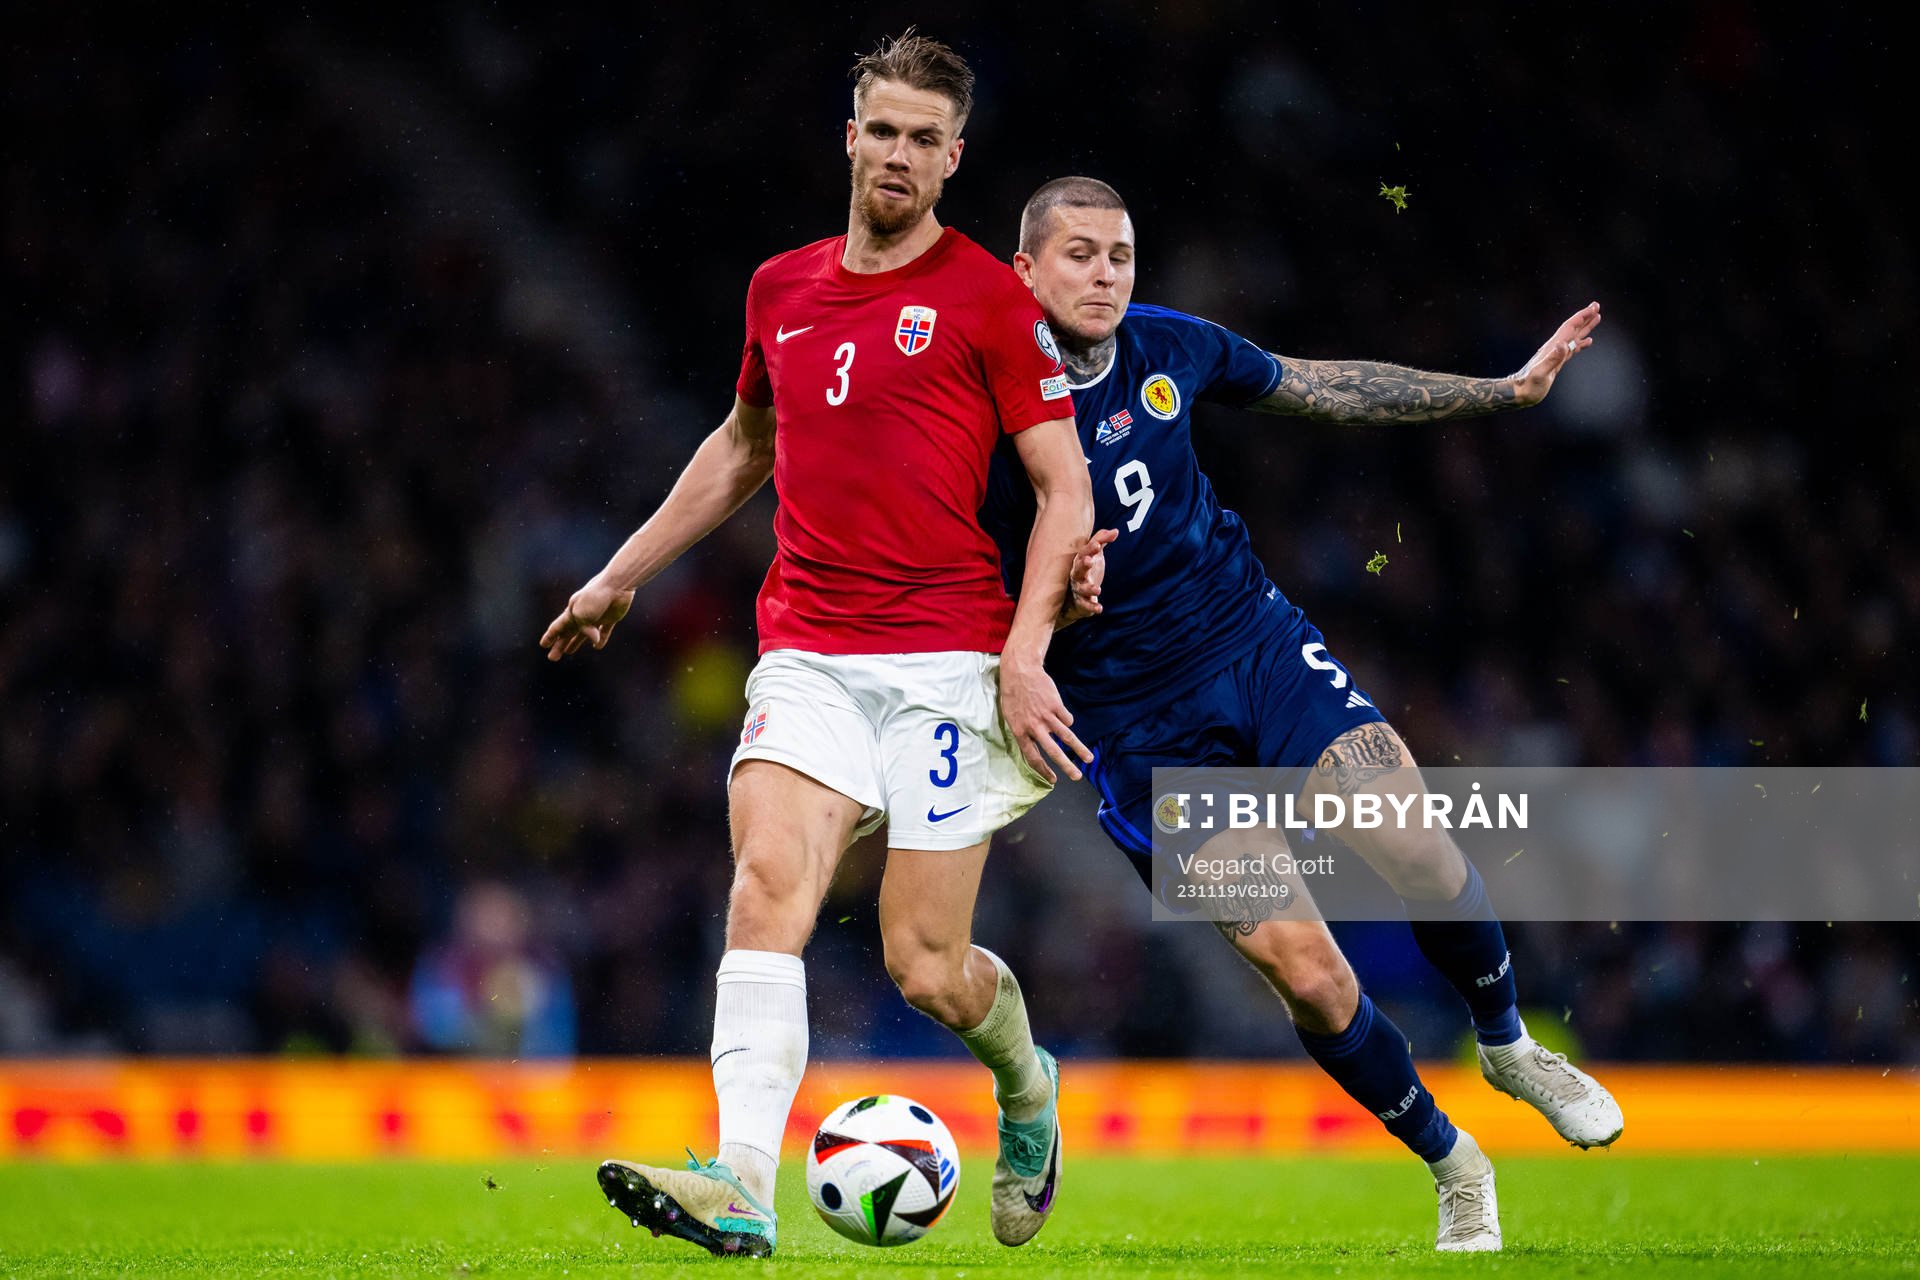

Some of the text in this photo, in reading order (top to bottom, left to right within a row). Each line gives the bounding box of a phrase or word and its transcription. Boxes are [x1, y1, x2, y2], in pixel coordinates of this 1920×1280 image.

[826, 341, 856, 406] 3
[1113, 459, 1155, 533] 9
[929, 722, 959, 788] 3
[1378, 1085, 1419, 1121] ALBA
